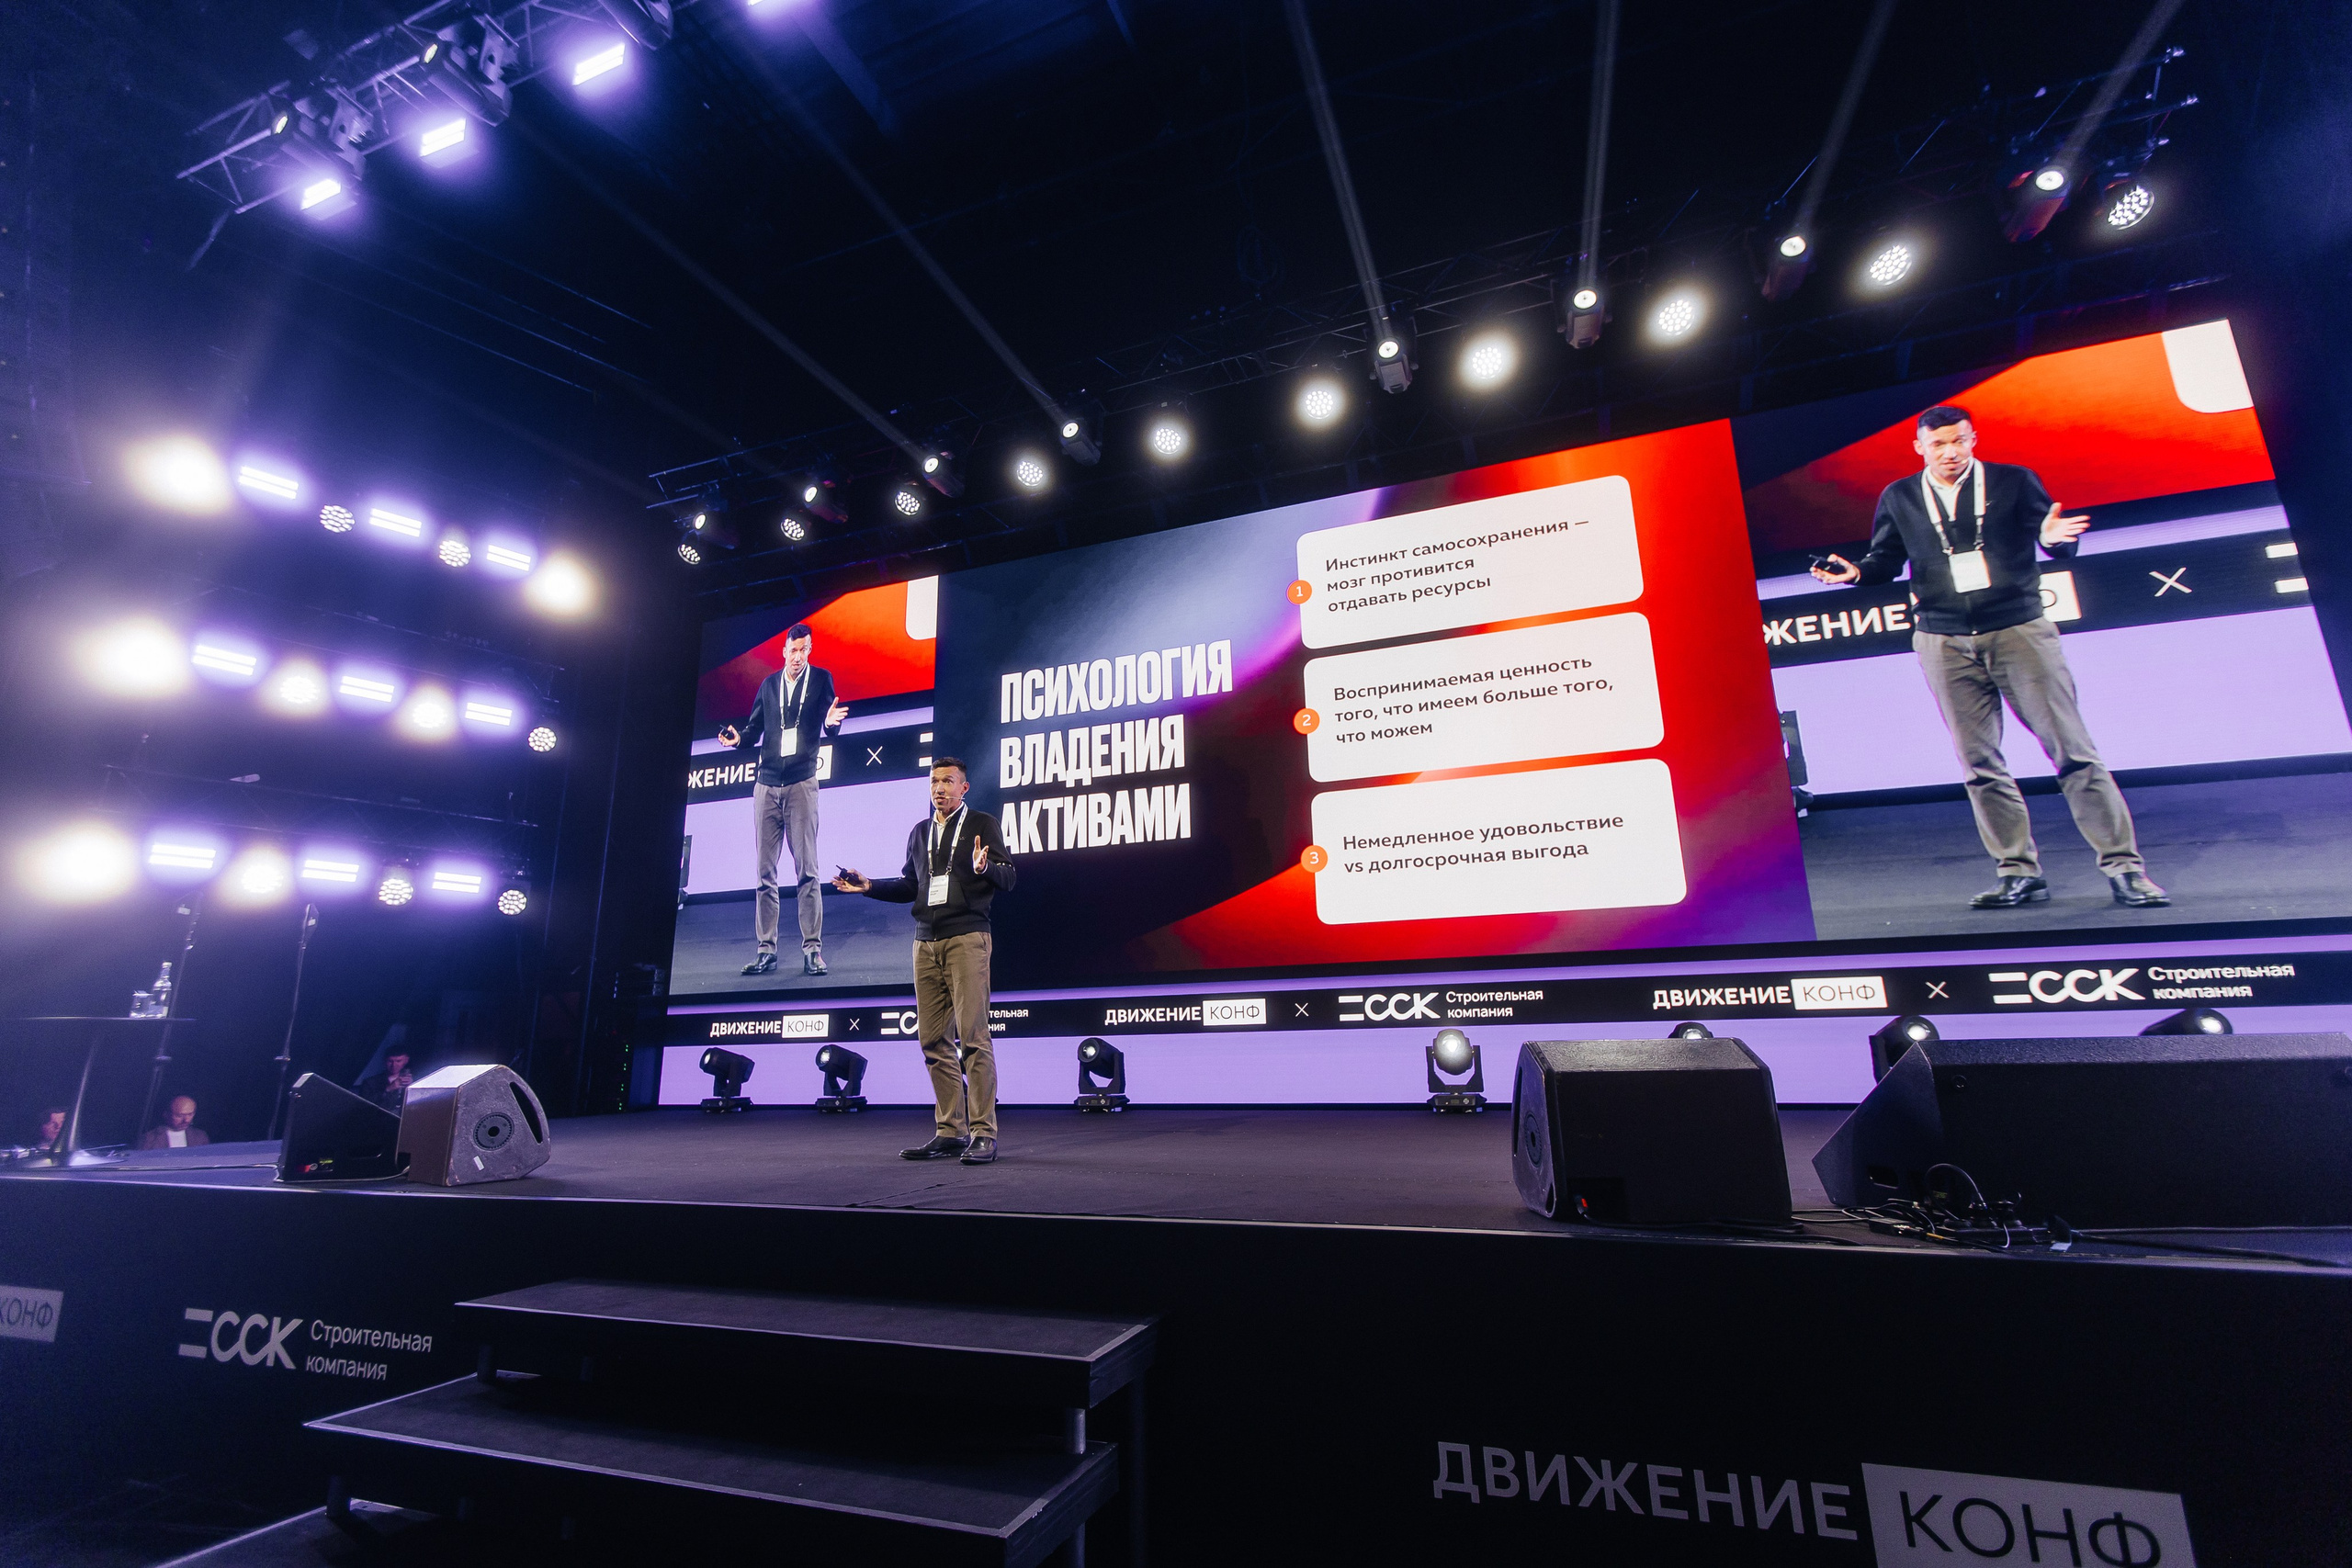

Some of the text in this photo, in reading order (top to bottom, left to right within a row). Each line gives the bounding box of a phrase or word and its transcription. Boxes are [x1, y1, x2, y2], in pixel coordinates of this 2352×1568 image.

[1325, 547, 1408, 572] Инстинкт
[1411, 520, 1569, 557] самосохранения
[1295, 585, 1304, 598] 1
[1326, 558, 1475, 592] мозг противится
[1328, 576, 1491, 613] отдавать ресурсы
[1762, 603, 1911, 646] ЖЕНИЕ
[1001, 639, 1233, 724] ПСИХОЛОГИЯ
[1333, 656, 1592, 701] Воспринимаемая ценность
[1335, 674, 1614, 723] того, что имеем больше того,
[1302, 714, 1311, 727] 2
[1336, 722, 1433, 744] что можем
[1000, 714, 1185, 788] ВЛАДЕНИЯ
[687, 762, 757, 789] ЖЕНИЕ
[1001, 783, 1192, 854] АКТИВАМИ
[1342, 814, 1624, 851] Немедленное удовольствие
[1309, 852, 1319, 865] 3
[1344, 840, 1589, 874] vs долгосрочная выгода
[1653, 984, 1791, 1010] ДВИЖЕНИЕ
[1802, 982, 1877, 1003] КОНФ
[2147, 961, 2296, 983] Строительная
[2152, 982, 2254, 1001] компания
[1104, 1005, 1202, 1026] ДВИЖЕНИЕ
[1209, 1003, 1261, 1020] КОНФ
[1445, 988, 1544, 1005] Строительная
[1447, 1005, 1514, 1021] компания
[709, 1019, 825, 1037] ДВИЖЕНИЕ КОНФ
[311, 1319, 433, 1353] Строительная
[305, 1355, 389, 1381] компания
[1432, 1440, 2162, 1568] ДВИЖЕНИЕ КОНФ
